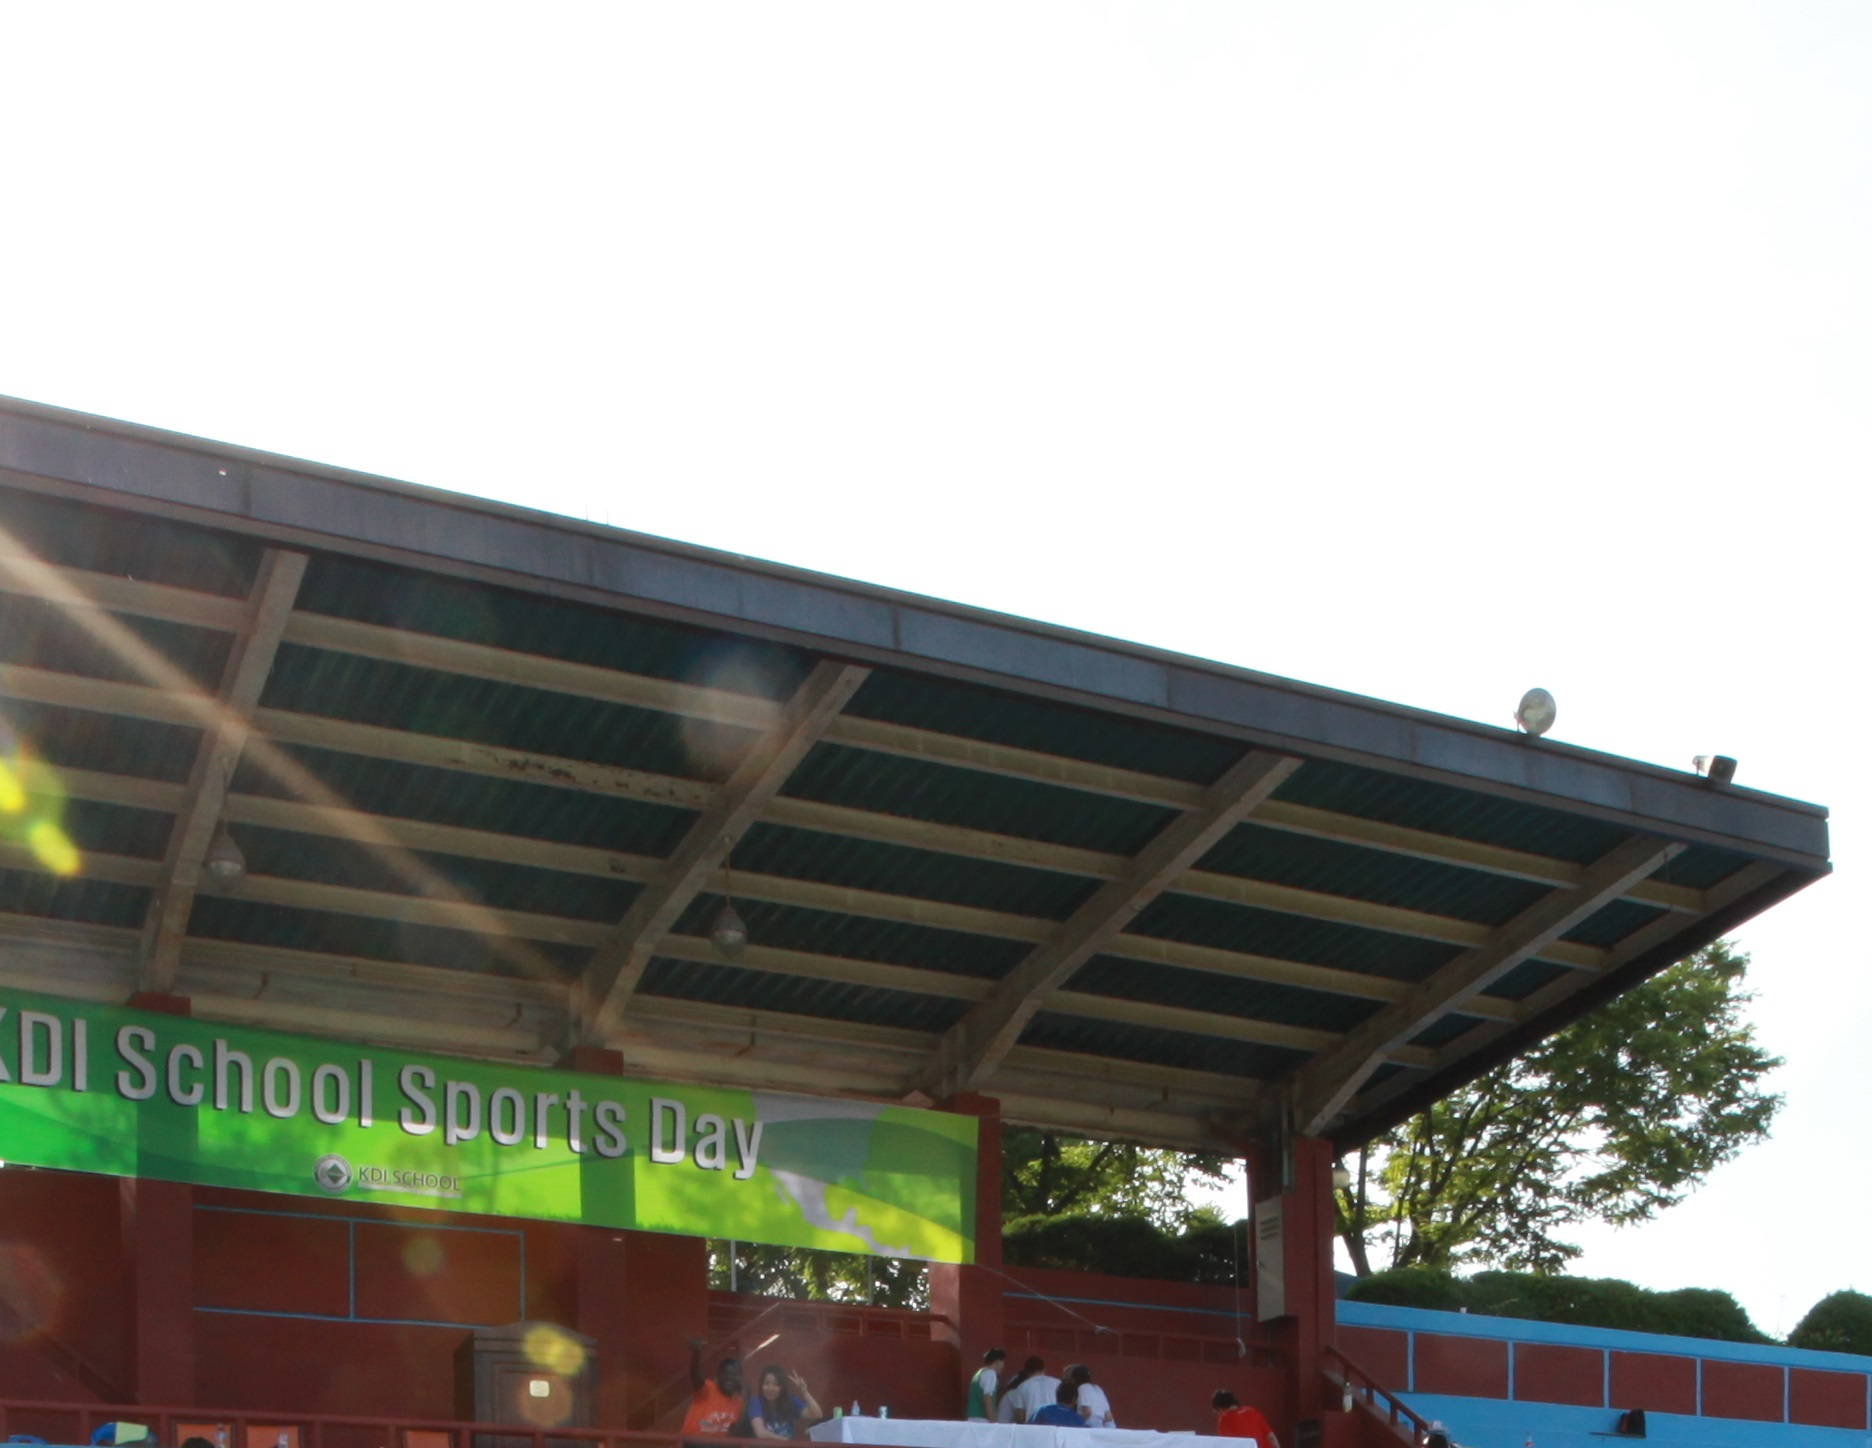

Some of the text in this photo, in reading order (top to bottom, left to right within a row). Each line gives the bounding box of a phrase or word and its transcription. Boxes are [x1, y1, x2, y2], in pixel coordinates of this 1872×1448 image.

[118, 1025, 376, 1128] School
[399, 1064, 627, 1159] Sports
[649, 1097, 764, 1181] Day
[359, 1167, 462, 1191] KDI SCHOOL
